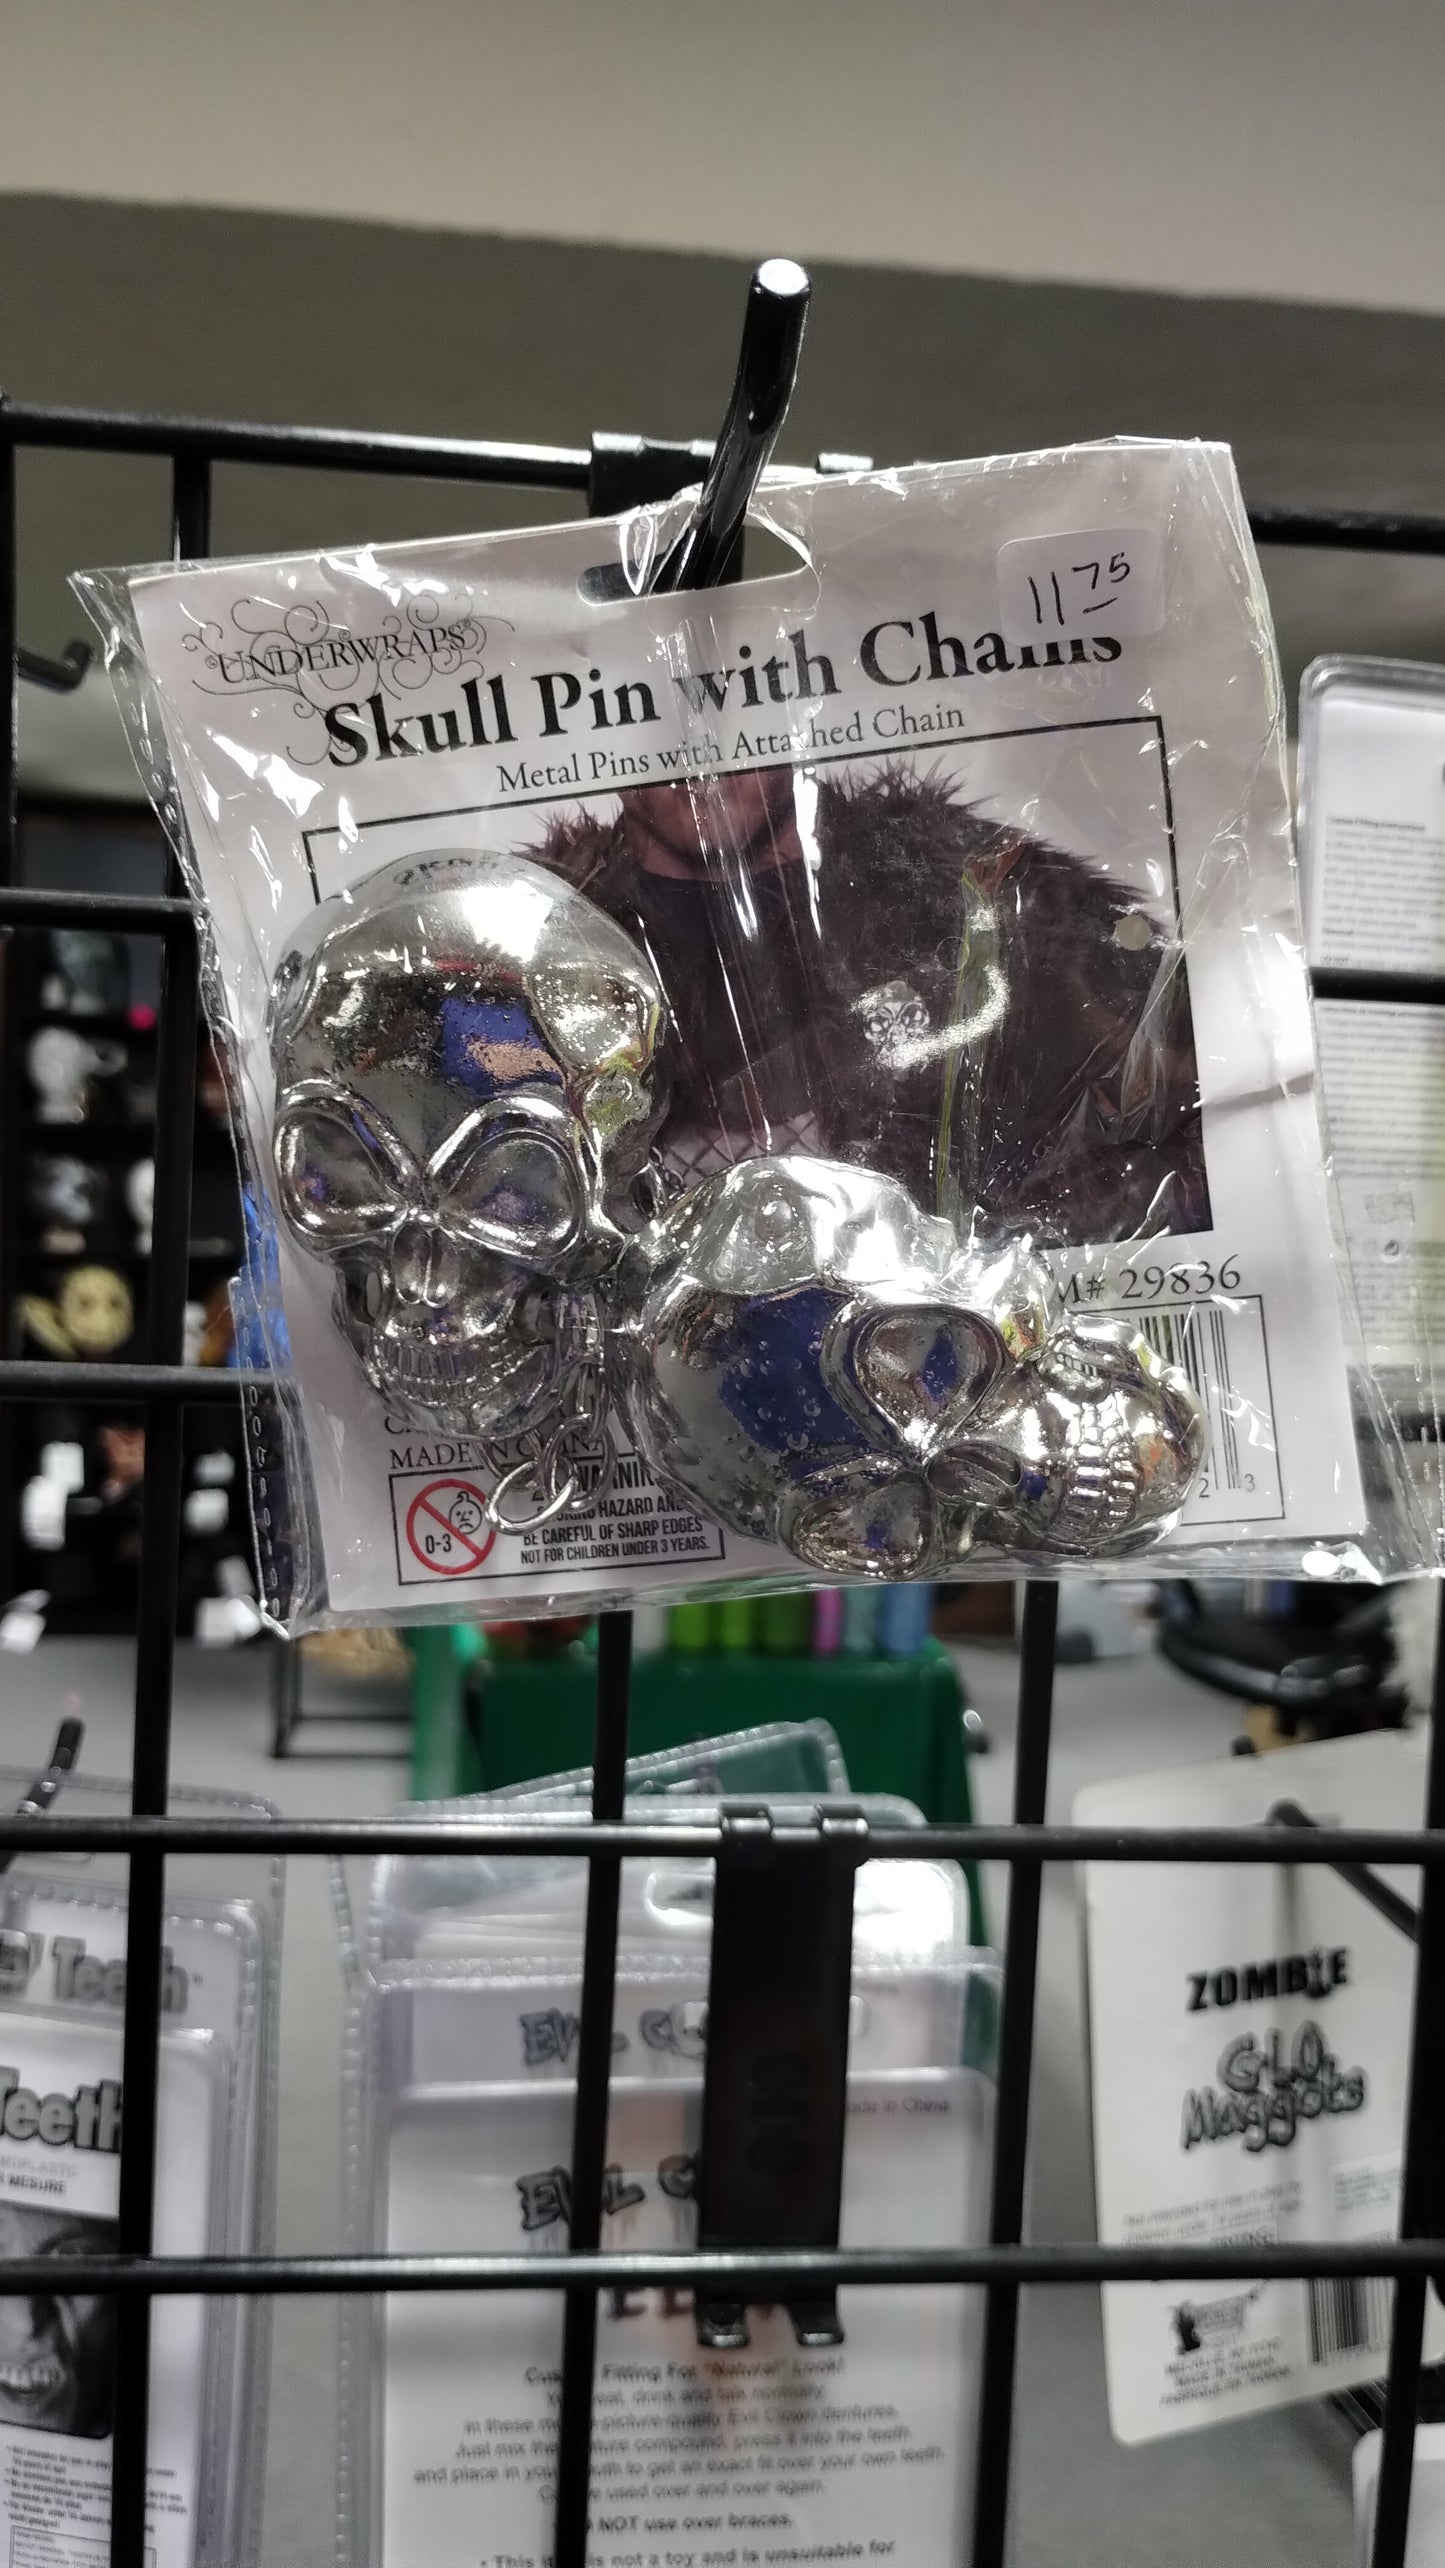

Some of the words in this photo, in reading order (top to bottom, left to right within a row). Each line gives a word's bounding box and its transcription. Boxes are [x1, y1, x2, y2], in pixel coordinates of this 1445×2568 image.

[216, 624, 467, 684] UNDERWRAPS
[324, 677, 517, 769] Skull
[531, 667, 662, 738] Pin
[671, 630, 843, 713] with
[496, 752, 582, 792] Metal
[588, 746, 650, 782] Pins
[657, 734, 724, 771] with
[872, 704, 965, 739] Chain
[1118, 1253, 1241, 1300] 29836
[390, 1441, 473, 1469] MADE
[542, 1524, 596, 1545] CAREFUL
[599, 1524, 614, 1541] OF
[616, 1519, 659, 1538] SHARP
[662, 1516, 704, 1535] EDGES
[599, 1496, 654, 1518] HAZARD
[424, 1534, 453, 1554] 0-3
[520, 1549, 541, 1565] NOT
[544, 1547, 565, 1563] FOR
[566, 1542, 620, 1561] CHILDREN
[622, 1539, 659, 1557] UNDER
[661, 1538, 669, 1553] 3
[671, 1535, 710, 1552] YEARS.
[53, 1935, 189, 2015] Teeh
[1187, 1945, 1349, 2012] ZOMBIE
